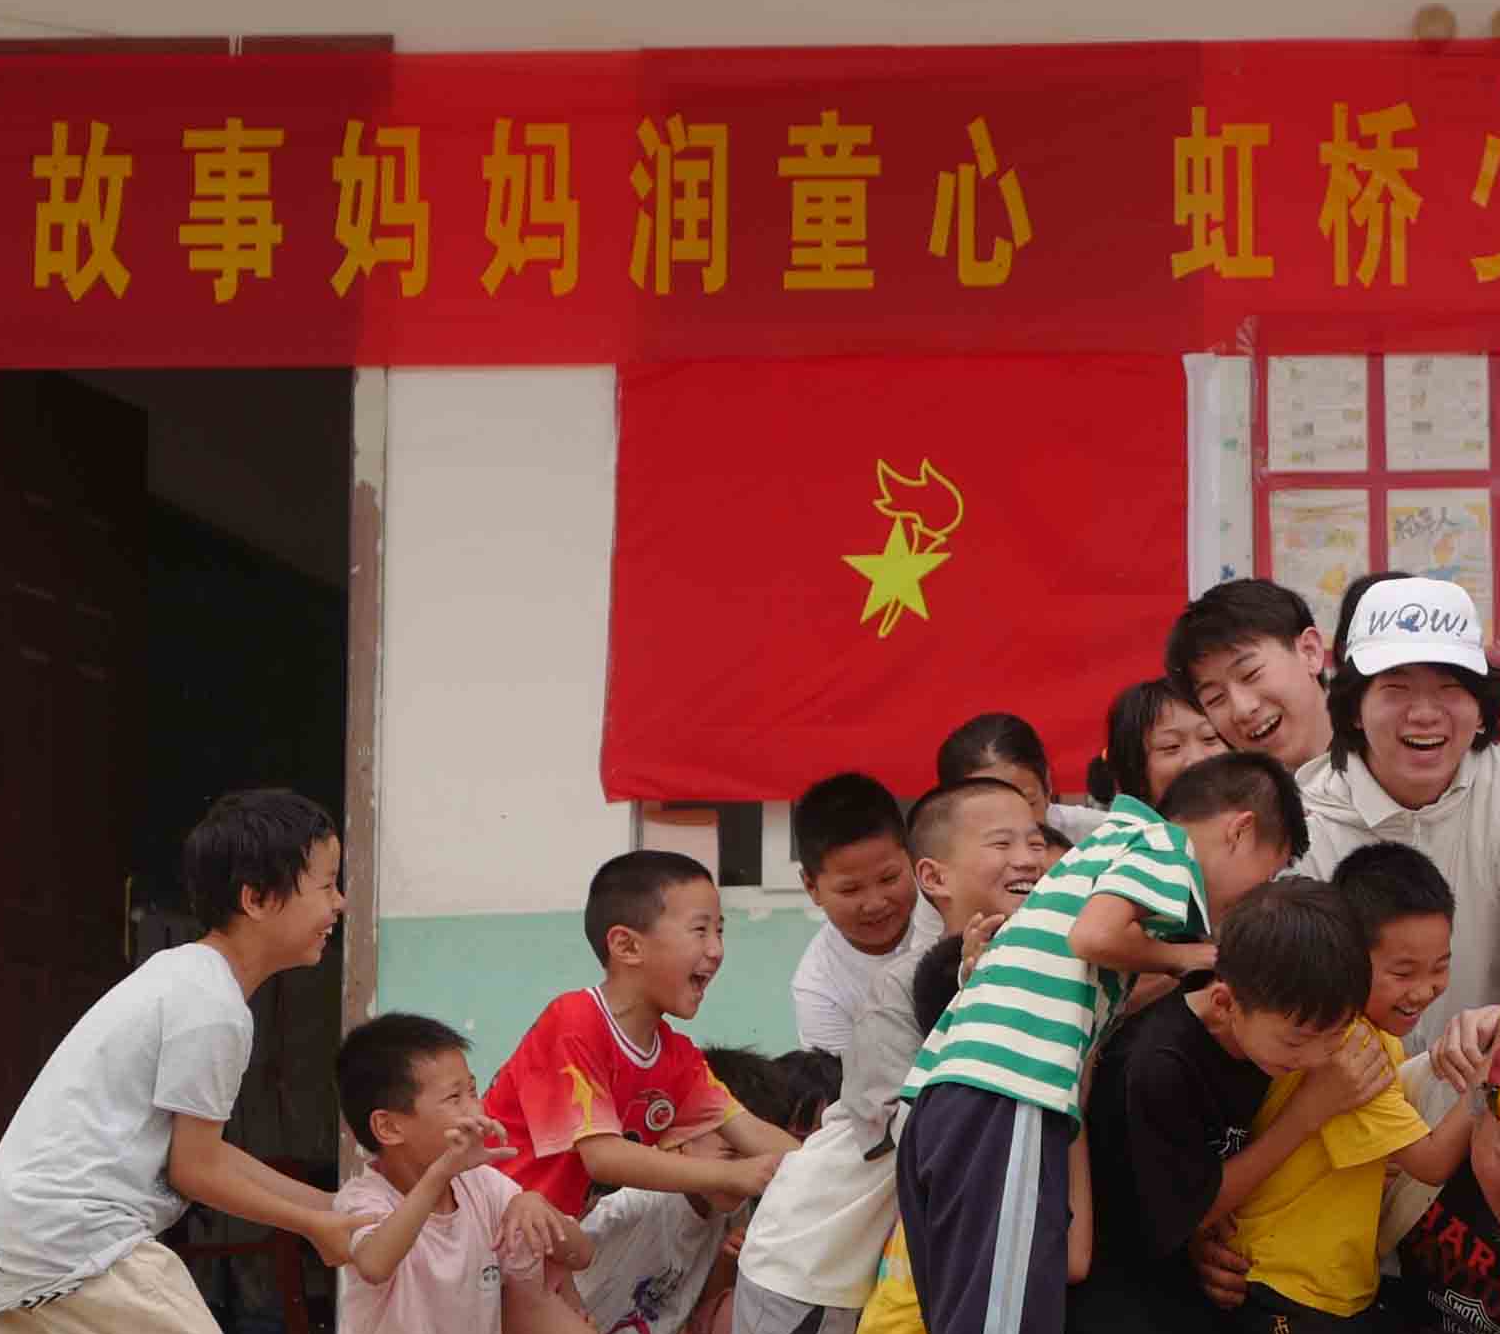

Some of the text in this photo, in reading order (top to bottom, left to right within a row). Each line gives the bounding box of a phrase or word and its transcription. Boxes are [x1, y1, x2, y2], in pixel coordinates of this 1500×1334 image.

[31, 111, 1033, 303] 故事妈妈润童心
